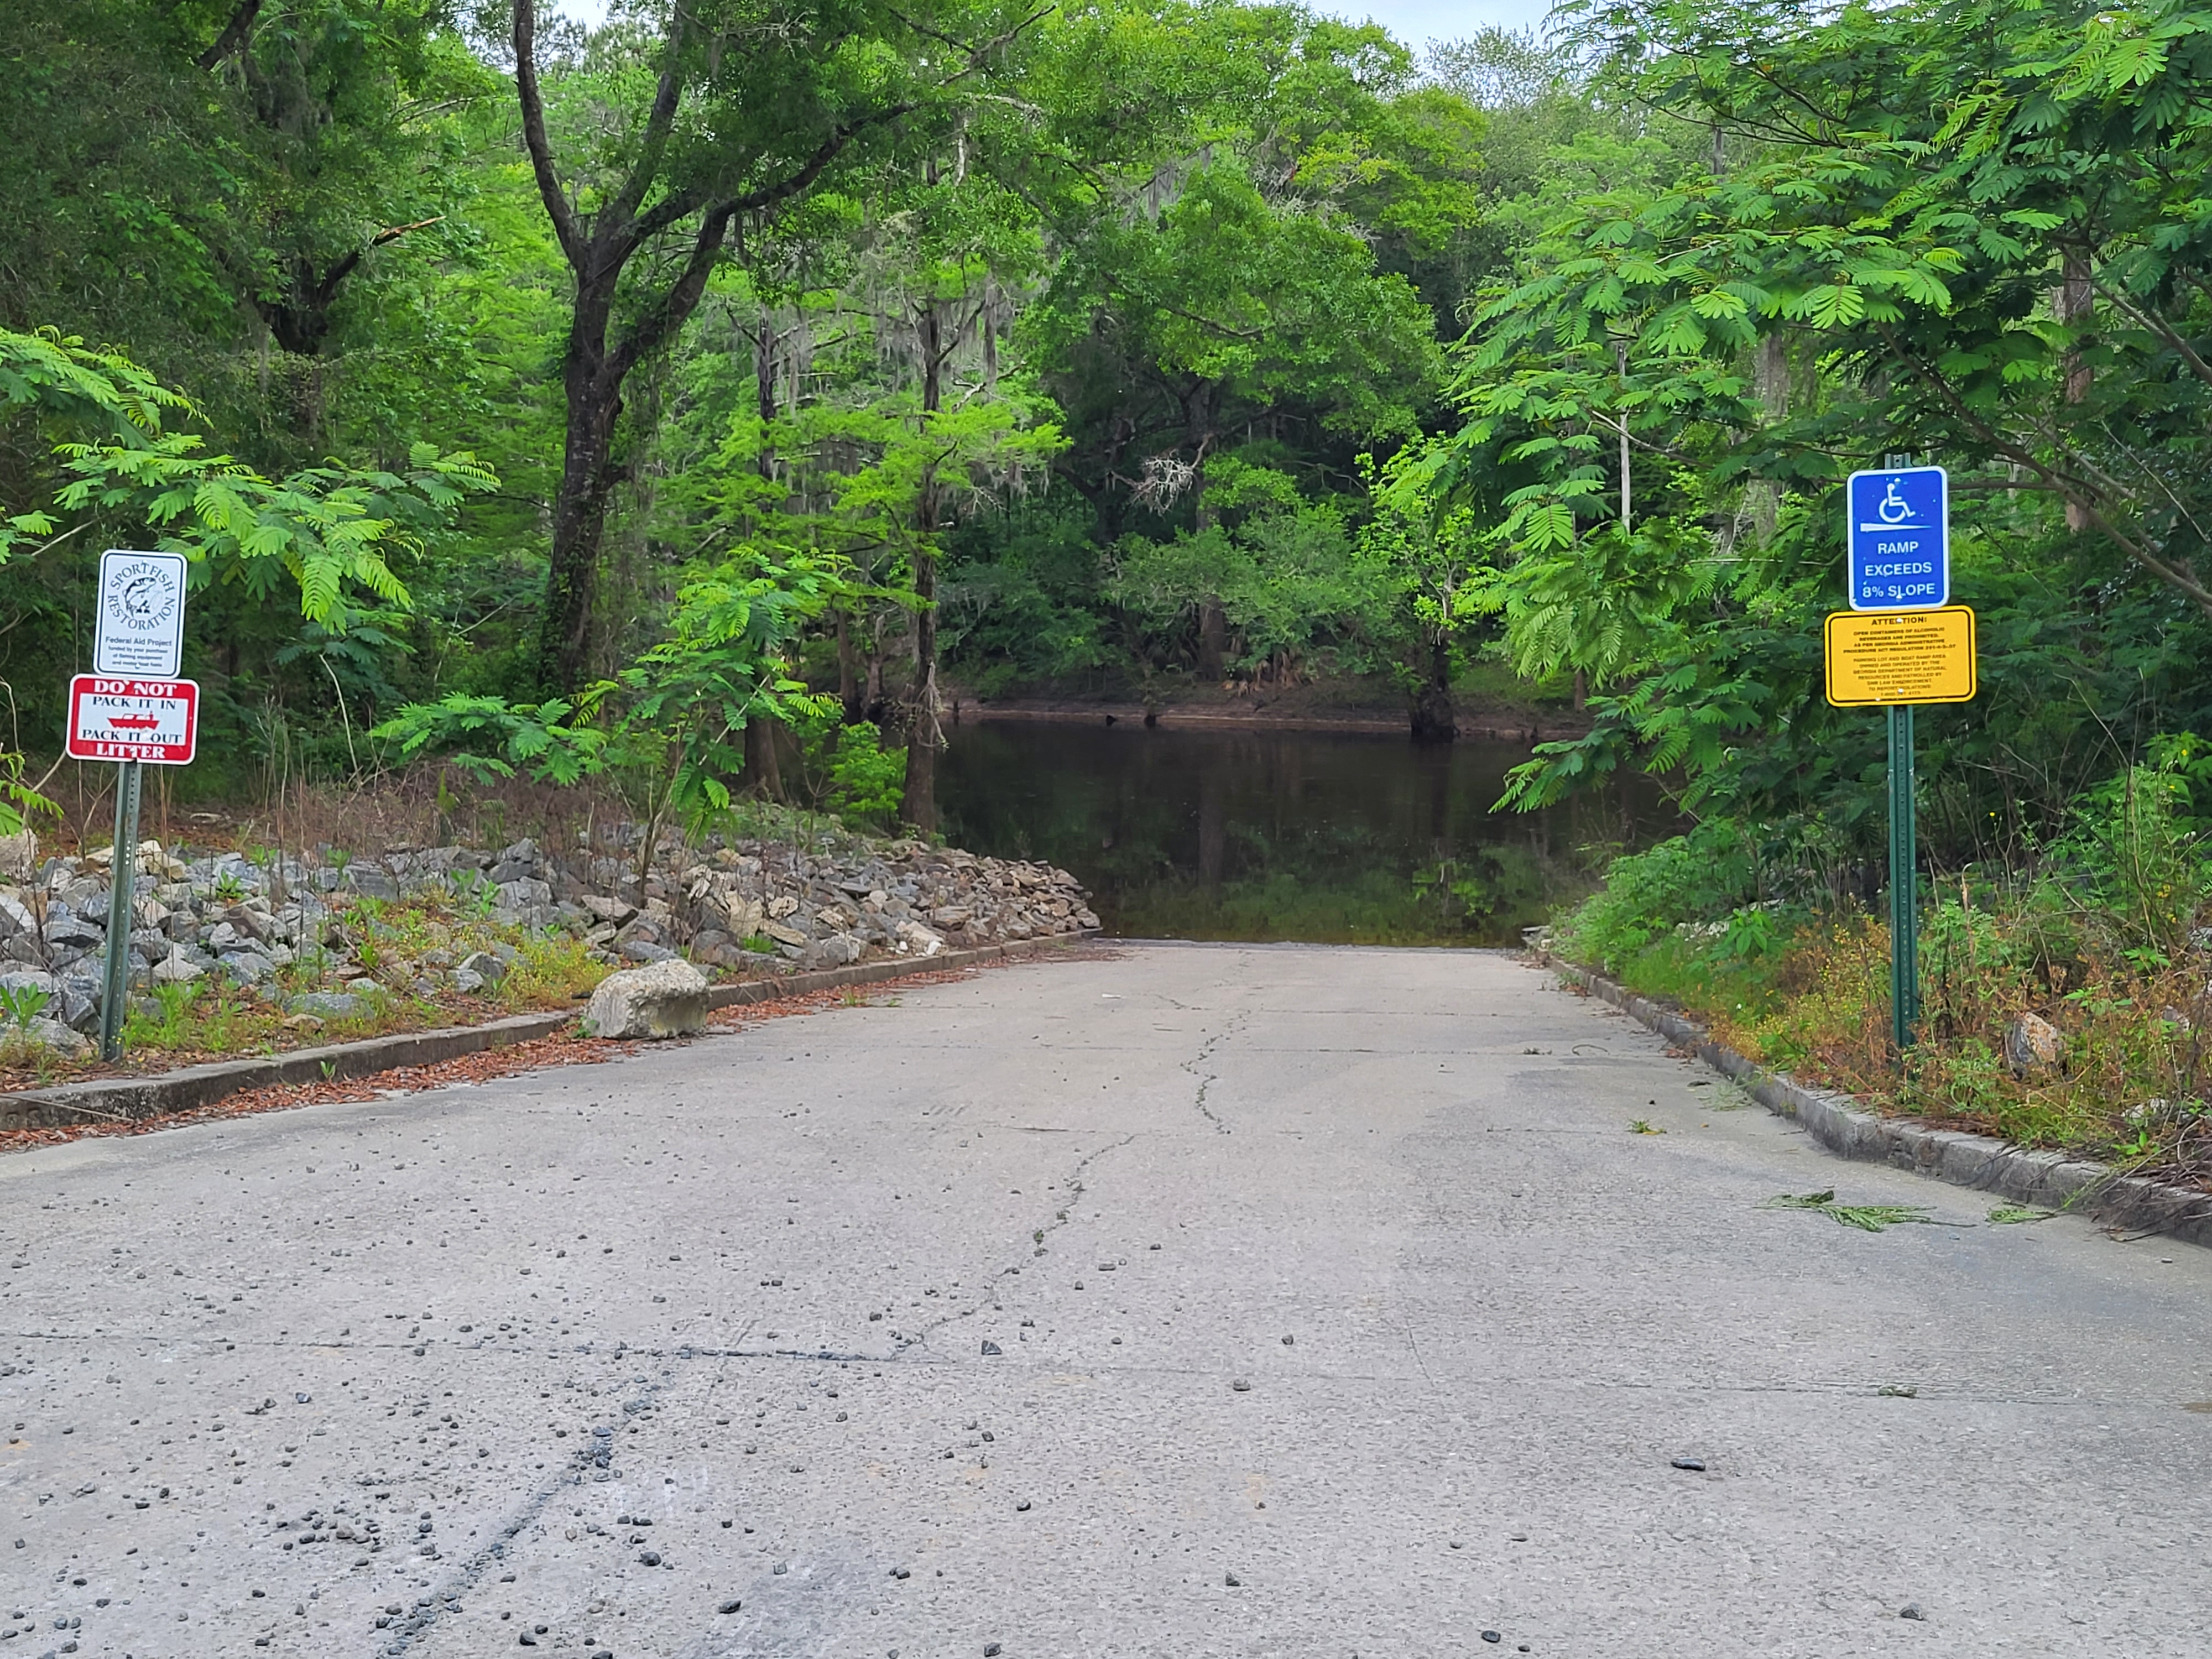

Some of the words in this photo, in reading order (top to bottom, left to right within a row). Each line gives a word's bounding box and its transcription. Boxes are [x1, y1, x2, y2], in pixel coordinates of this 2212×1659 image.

[1877, 541, 1918, 555] RAMP
[1865, 561, 1932, 576] EXCEEDS
[149, 565, 175, 593] FISH
[1863, 586, 1884, 598] 8%
[1887, 583, 1935, 597] SLOPE
[108, 595, 175, 630] RESTORATION
[1871, 616, 1927, 625] ATTETION:
[106, 636, 132, 644] Federal
[133, 637, 145, 645] Aid
[147, 639, 172, 648] Project
[94, 680, 126, 693] DO
[134, 682, 177, 696] NOT
[93, 696, 131, 707] PACK
[139, 699, 153, 708] IT
[160, 700, 176, 710] IN
[82, 729, 119, 740] PACK
[128, 733, 142, 742] IT
[150, 733, 182, 744] OUT
[96, 743, 165, 759] LITTER
